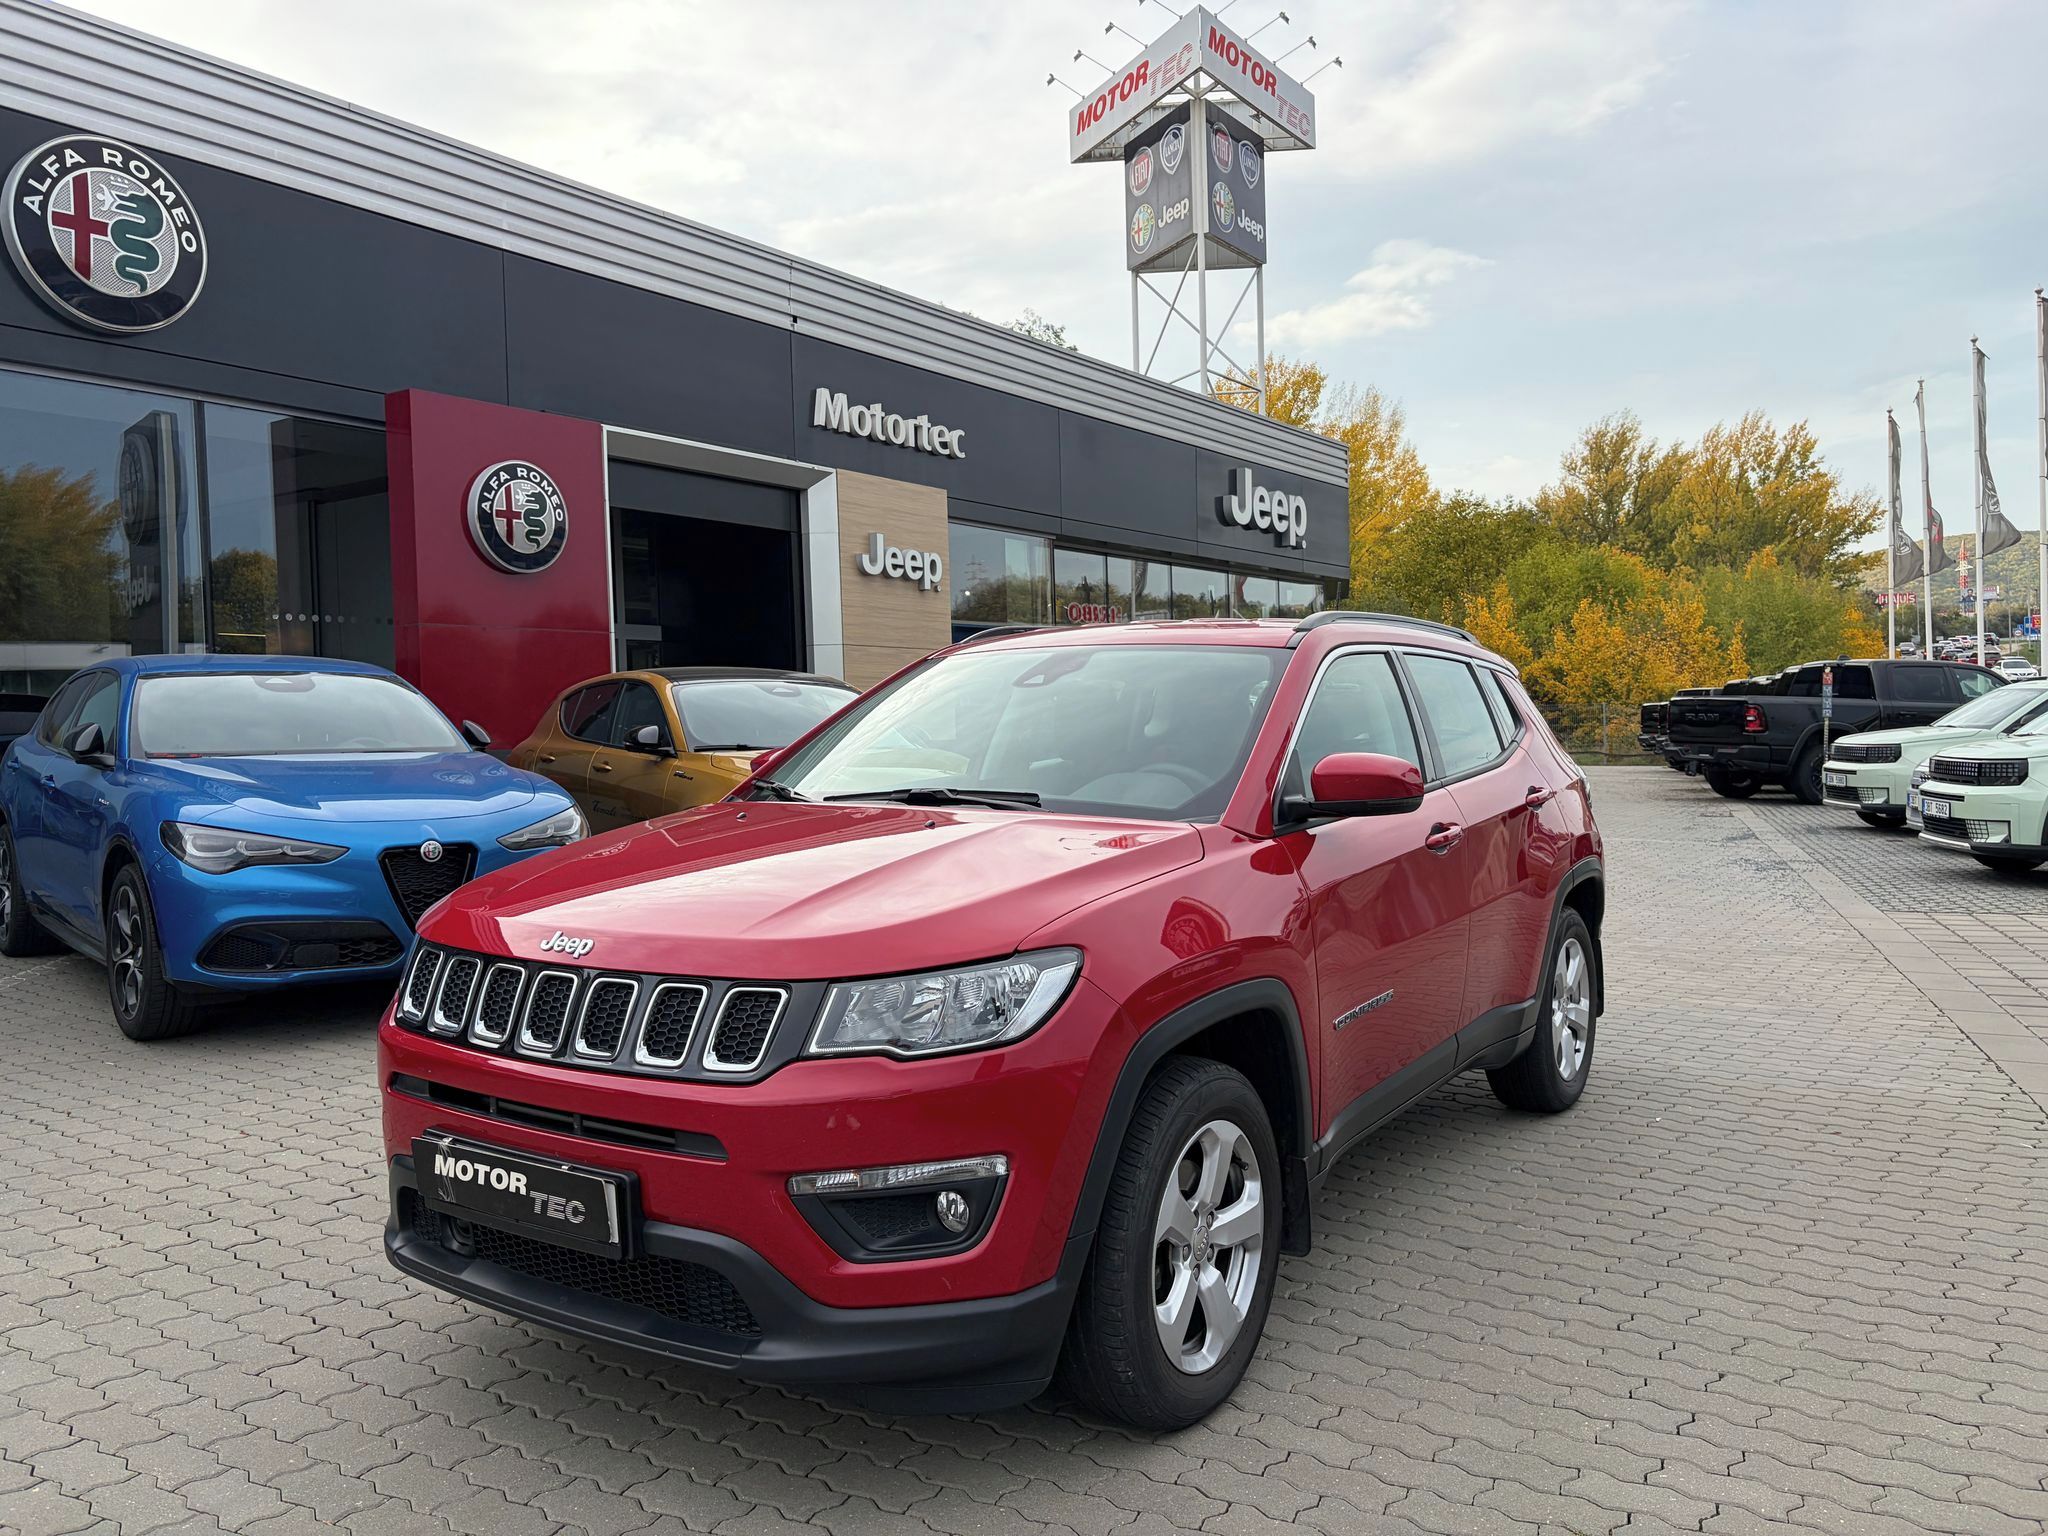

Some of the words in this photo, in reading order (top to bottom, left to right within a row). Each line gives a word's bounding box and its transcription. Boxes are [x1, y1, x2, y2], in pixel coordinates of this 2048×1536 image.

[1076, 60, 1149, 136] MOTOR
[1149, 42, 1193, 96] TEC
[1208, 25, 1277, 97] MOTOR
[1275, 94, 1311, 137] TEC
[1134, 158, 1149, 185] FIAT
[1216, 135, 1229, 162] FIAT
[23, 148, 86, 216] ALFA
[102, 147, 197, 253] ROMEO
[1158, 198, 1189, 228] Jeep
[1238, 209, 1264, 242] Jeep
[813, 387, 966, 459] Motortec
[481, 471, 510, 513] ALFA
[516, 467, 564, 522] ROMEO
[1224, 467, 1308, 549] Jeep
[857, 532, 943, 591] Jeep
[1685, 712, 1720, 722] RAM
[540, 930, 594, 959] Jeep
[434, 1154, 527, 1196] MOTOR
[529, 1190, 586, 1224] TEC
